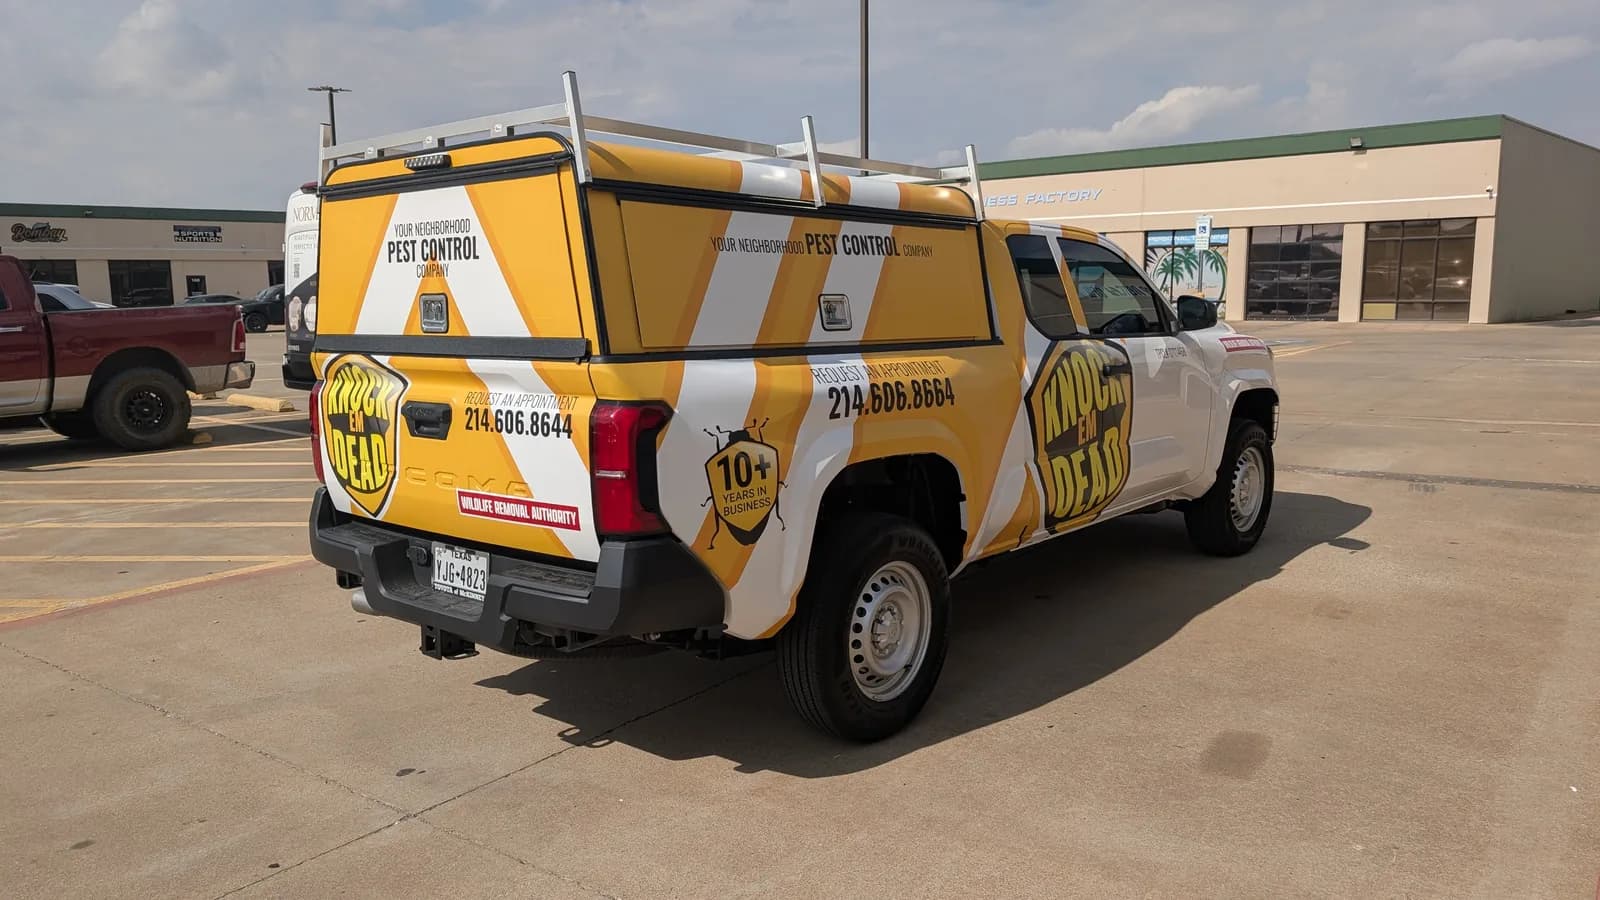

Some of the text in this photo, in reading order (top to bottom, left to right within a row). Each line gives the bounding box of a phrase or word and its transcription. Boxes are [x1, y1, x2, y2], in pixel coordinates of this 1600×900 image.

[1025, 187, 1104, 205] FACTORY
[11, 222, 68, 242] Bombay
[394, 218, 471, 238] YOUR NEIGHBORHOOD
[388, 236, 480, 264] PEST CONTROL
[710, 232, 934, 257] YOUR NEIGHBORHOOD PEST CONTROL COMPANY
[416, 263, 449, 278] COMPANY
[811, 360, 946, 385] REQUEST AN APPOINTMENT
[328, 364, 394, 420] KNOCK
[464, 391, 580, 411] REQUEST AN APPOINTMENT
[828, 377, 955, 420] 214.606.8664
[349, 409, 364, 433] EM
[464, 407, 573, 439] 214.606.8644
[1078, 409, 1097, 447] EM
[332, 431, 387, 490] DEAD
[717, 450, 772, 491] 10+
[1051, 427, 1124, 518] DEAD
[722, 486, 767, 504] YEARS IN
[723, 497, 772, 517] BUSINESS
[460, 496, 577, 526] WILDLIFE REMOVAL AUTHORITY
[451, 551, 472, 561] TEXAS
